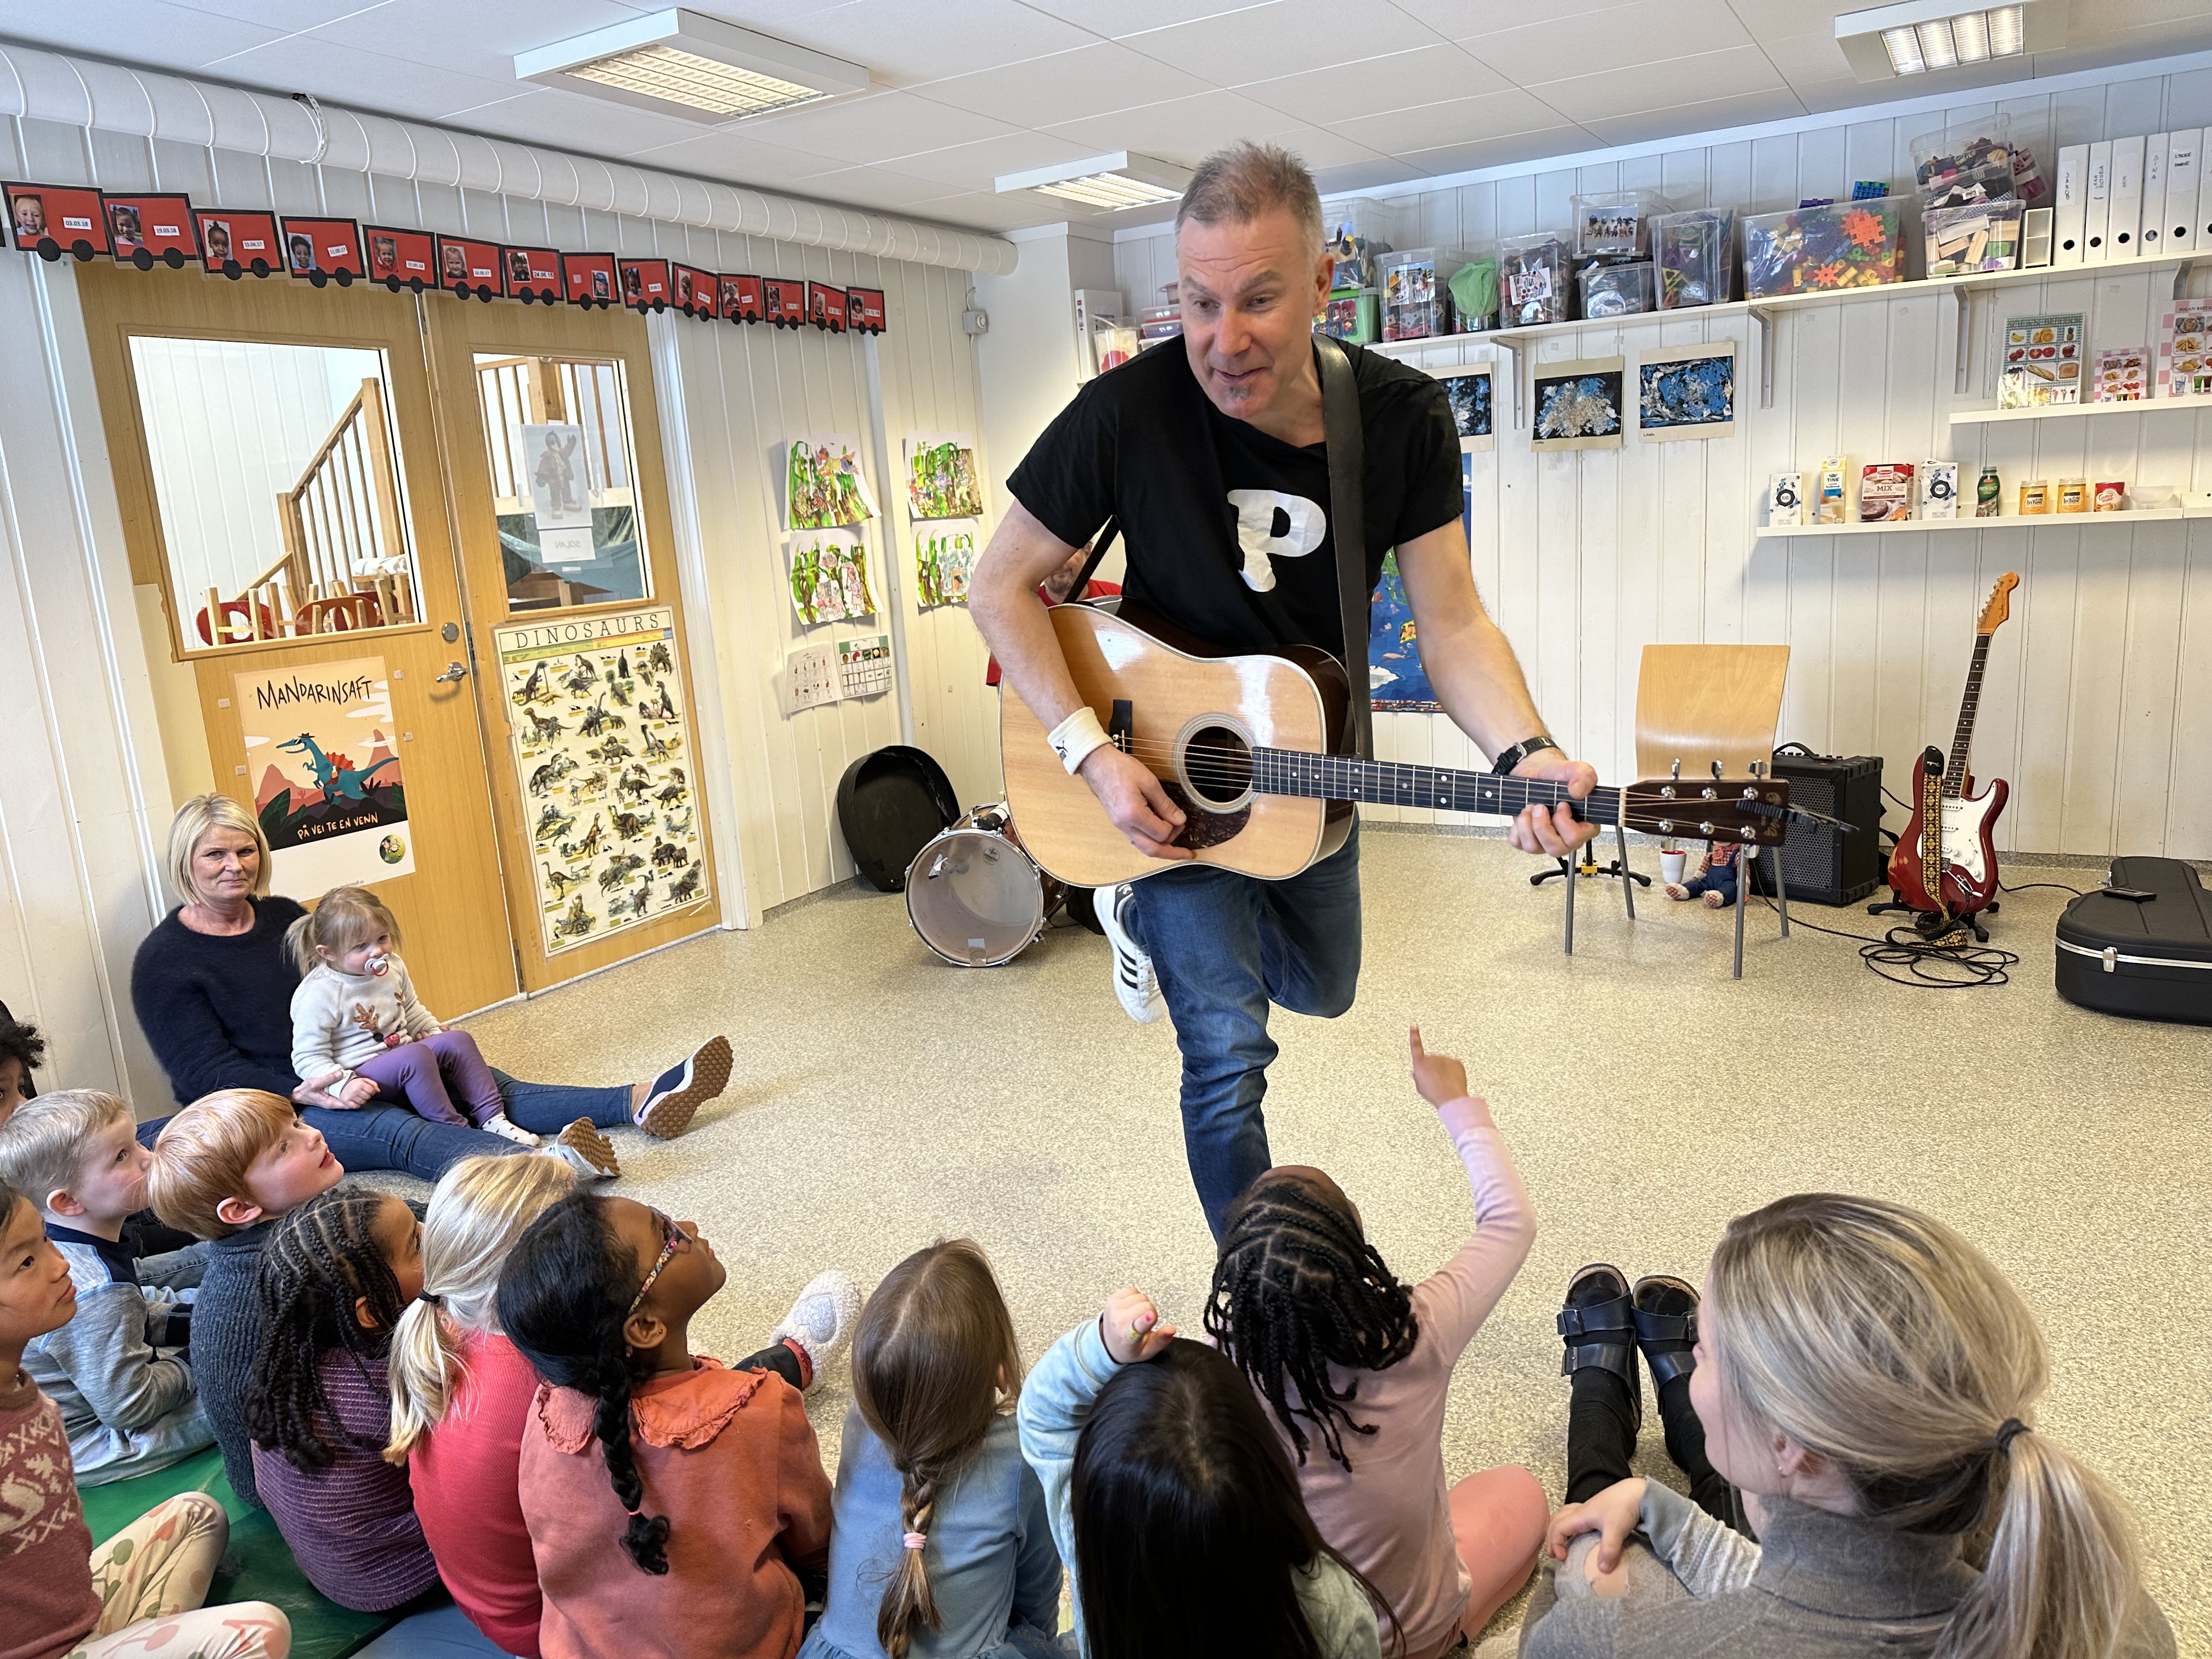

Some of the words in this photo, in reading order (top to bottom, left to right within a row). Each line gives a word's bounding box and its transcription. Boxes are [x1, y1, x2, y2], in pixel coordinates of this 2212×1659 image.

[1227, 489, 1327, 592] P
[515, 614, 658, 648] DINOSAURS
[257, 675, 373, 710] MANDARINSAFT
[297, 824, 310, 840] PÅ
[311, 824, 325, 835] VEI
[326, 822, 337, 832] TE
[339, 817, 351, 830] EN
[353, 811, 379, 827] VENN
